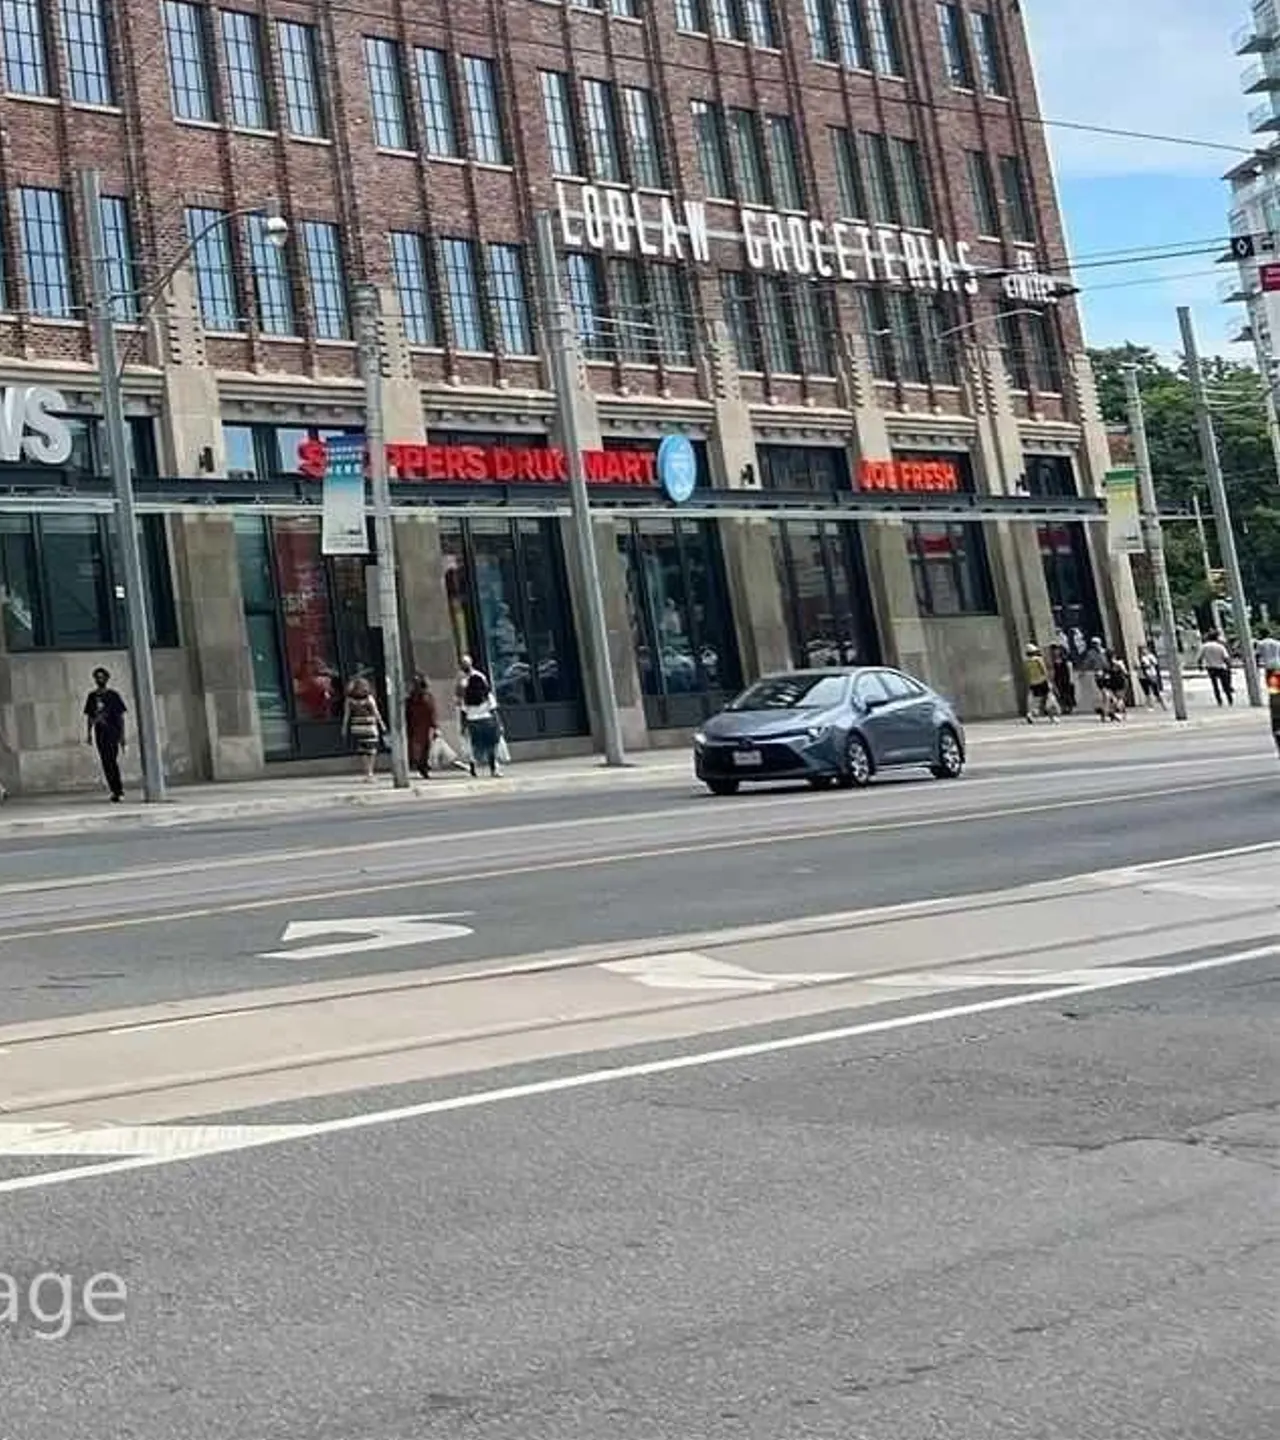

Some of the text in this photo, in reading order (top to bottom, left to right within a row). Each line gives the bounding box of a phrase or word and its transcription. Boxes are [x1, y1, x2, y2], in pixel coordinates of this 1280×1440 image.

[556, 180, 979, 295] LOBLAW GROCETERIAS
[863, 461, 959, 491] JOE FRESH
